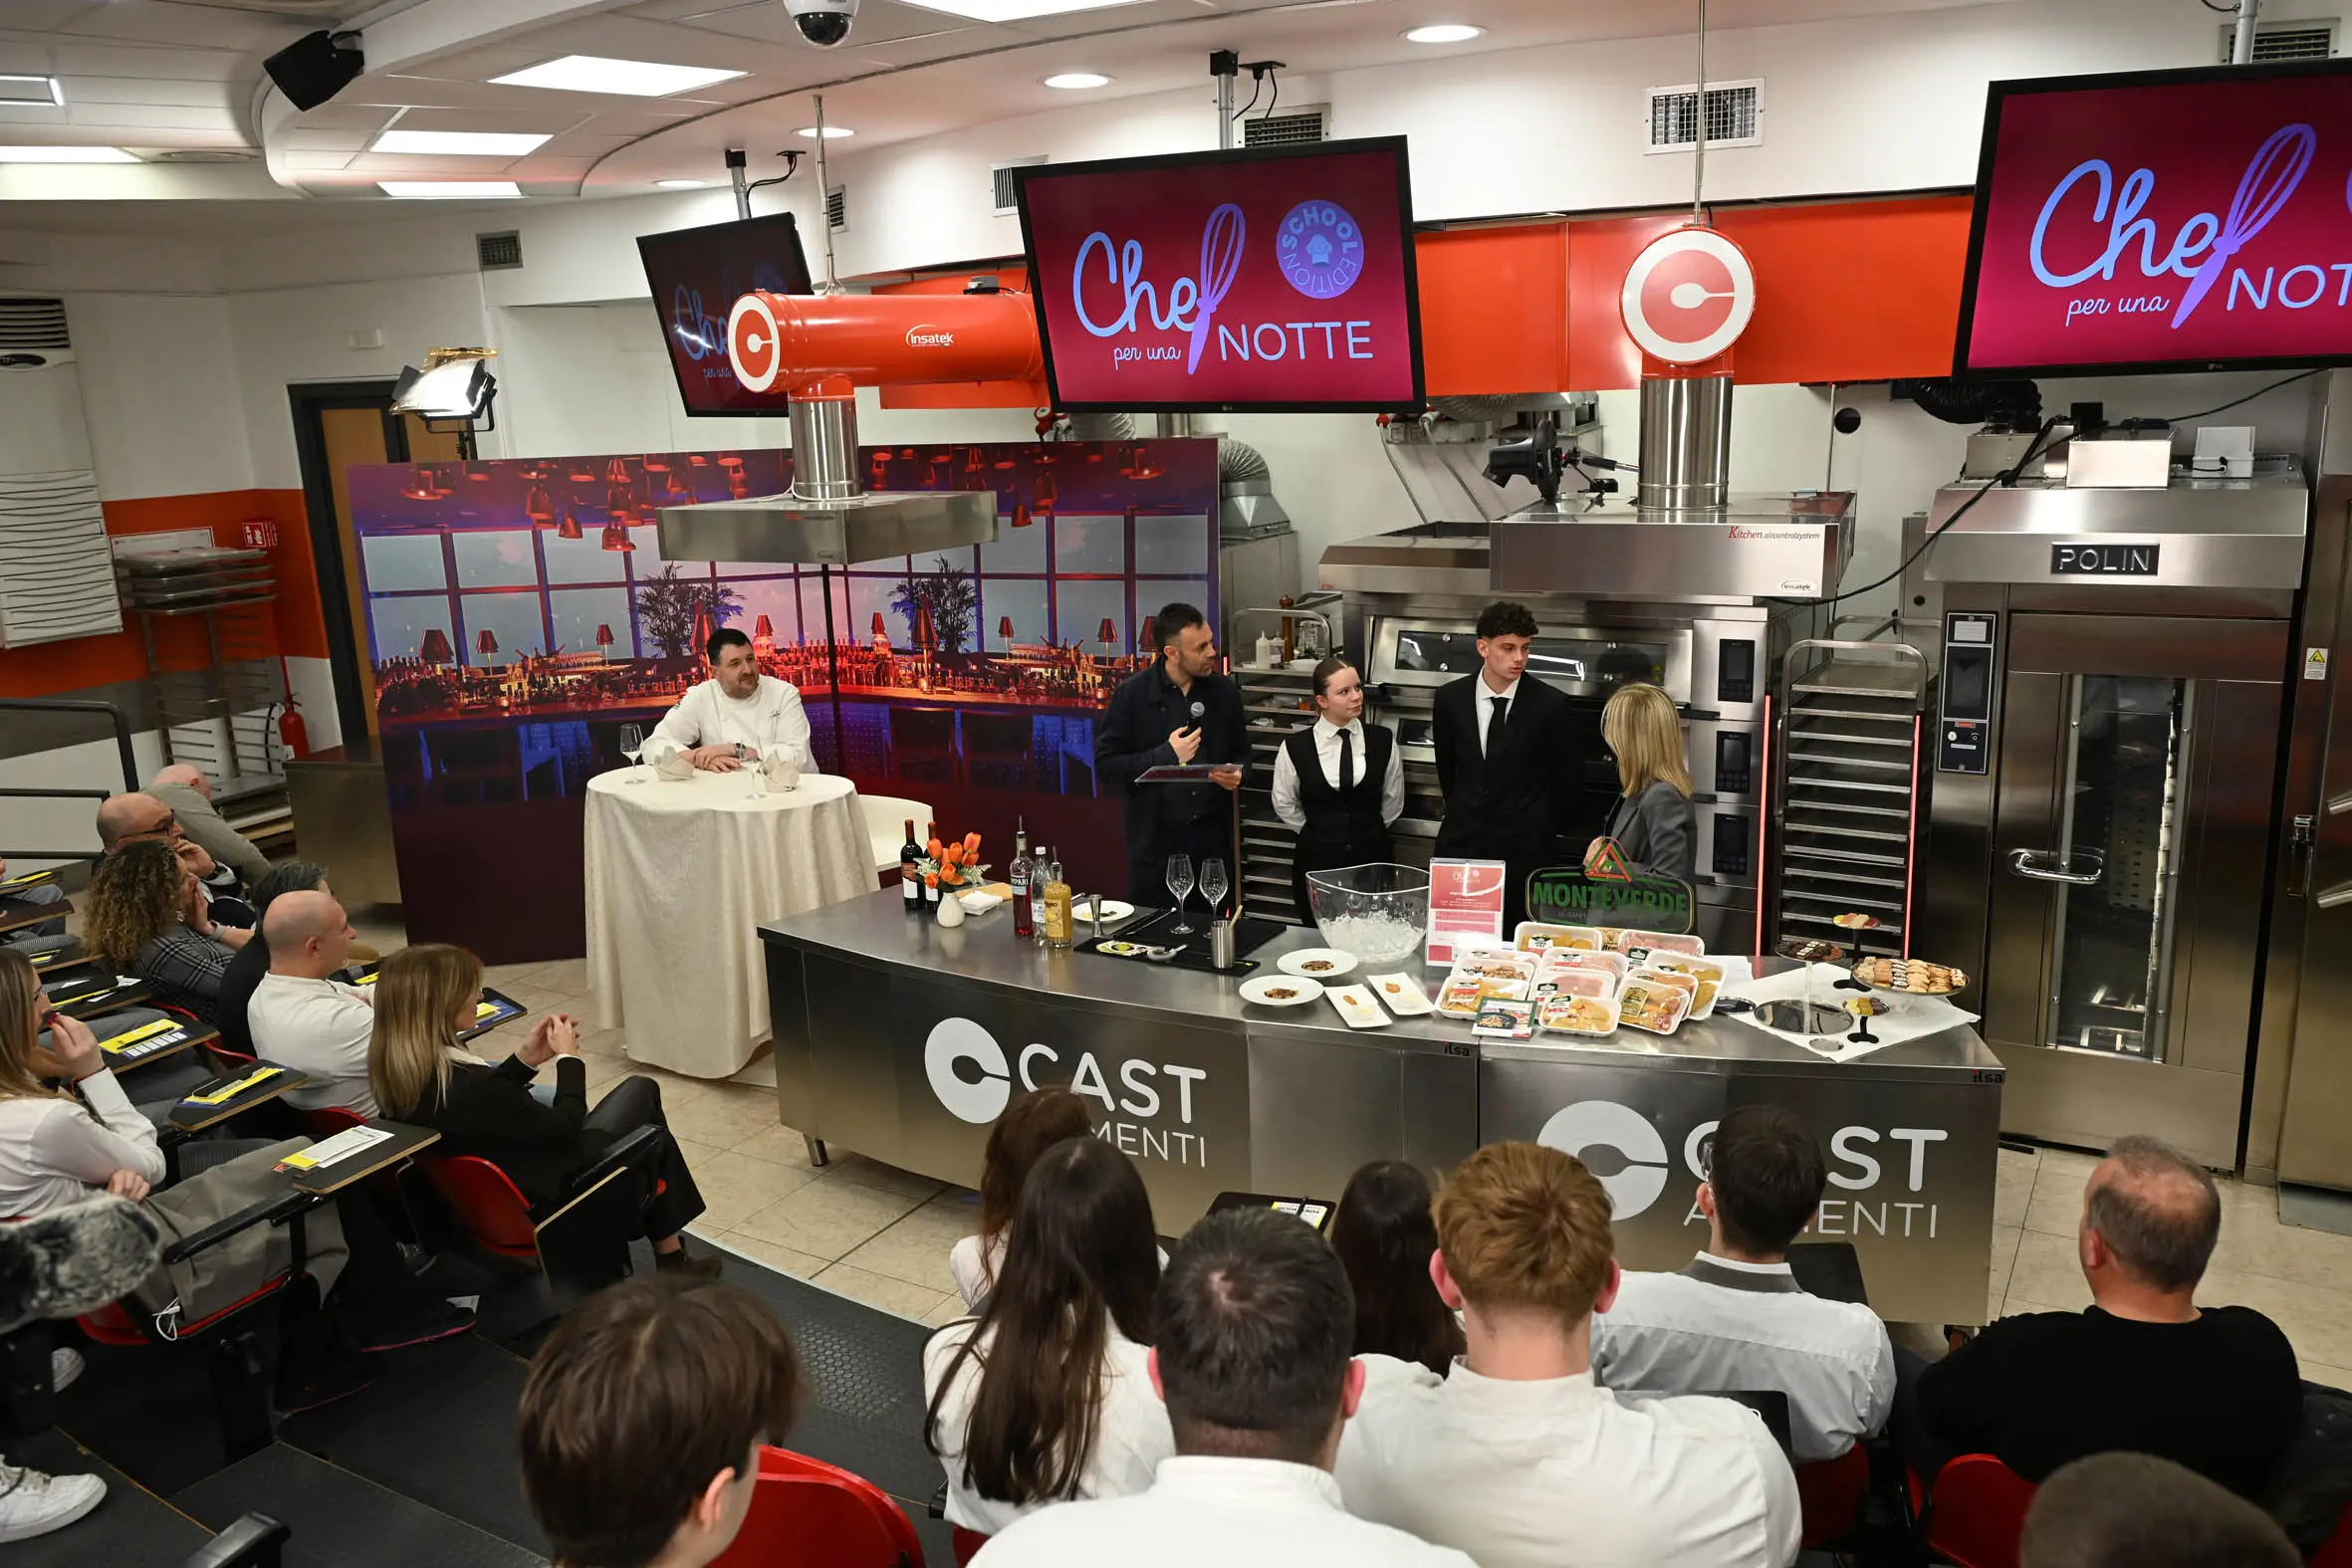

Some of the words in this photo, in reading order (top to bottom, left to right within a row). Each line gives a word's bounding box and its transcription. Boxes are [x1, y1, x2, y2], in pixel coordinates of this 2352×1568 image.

[1283, 205, 1358, 254] SCHOOL
[1283, 253, 1357, 293] EDITION
[2065, 297, 2111, 327] per
[2116, 296, 2170, 314] una
[908, 328, 954, 345] insatek
[1113, 345, 1142, 370] per
[1146, 345, 1182, 360] una
[1218, 321, 1374, 361] NOTTE
[2059, 549, 2150, 571] POLIN
[1532, 881, 1687, 916] MONTEVERDE
[1019, 1043, 1207, 1124] CAST
[1684, 1120, 1948, 1192] CST
